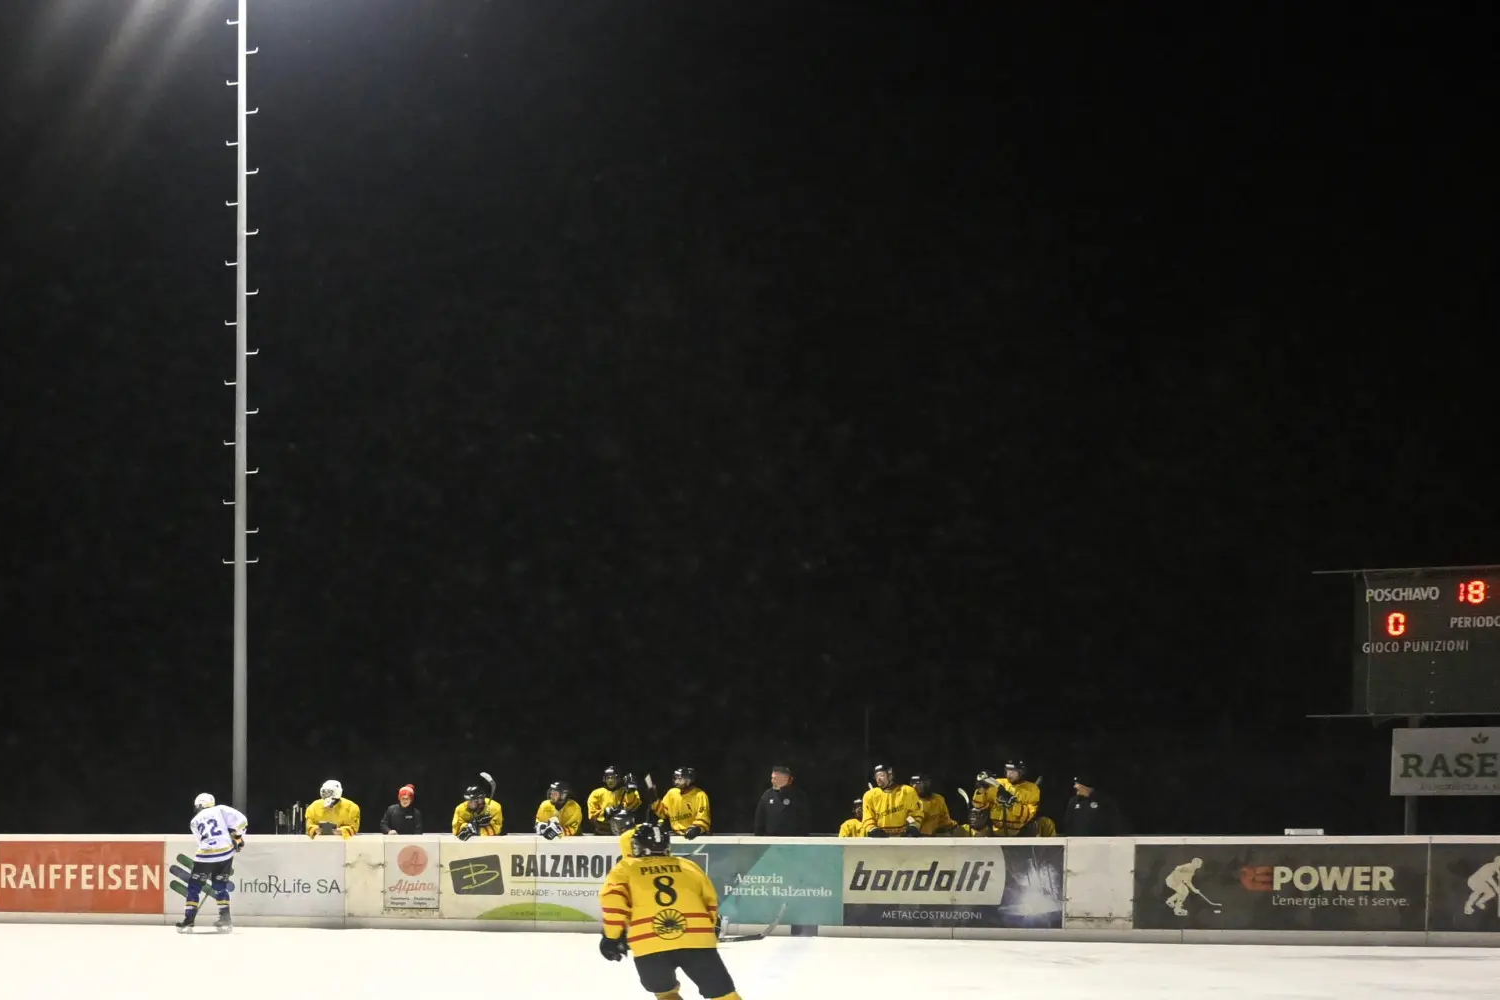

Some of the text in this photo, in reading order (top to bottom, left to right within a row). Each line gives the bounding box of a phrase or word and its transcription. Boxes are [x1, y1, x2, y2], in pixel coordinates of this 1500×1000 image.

[1365, 586, 1440, 602] POSCHIAVO
[1458, 580, 1485, 604] 18
[1387, 612, 1405, 636] 0
[1362, 640, 1470, 654] GIOCO PUNIZIONI
[511, 853, 622, 879] BALZAROL
[0, 863, 160, 890] RAIFFEISEN
[734, 872, 784, 886] Agenzia
[849, 860, 994, 892] bondolfi
[316, 878, 342, 894] SA
[388, 878, 435, 895] Alpina
[510, 888, 550, 897] BEVANDE
[557, 889, 600, 897] TRASPORT
[653, 875, 678, 907] 8
[724, 885, 833, 898] Patrick Balzarolo
[1332, 895, 1355, 906] che
[1358, 895, 1368, 906] ti
[1371, 897, 1410, 907] serve.
[881, 909, 983, 921] METALCOSTRUZIONI
